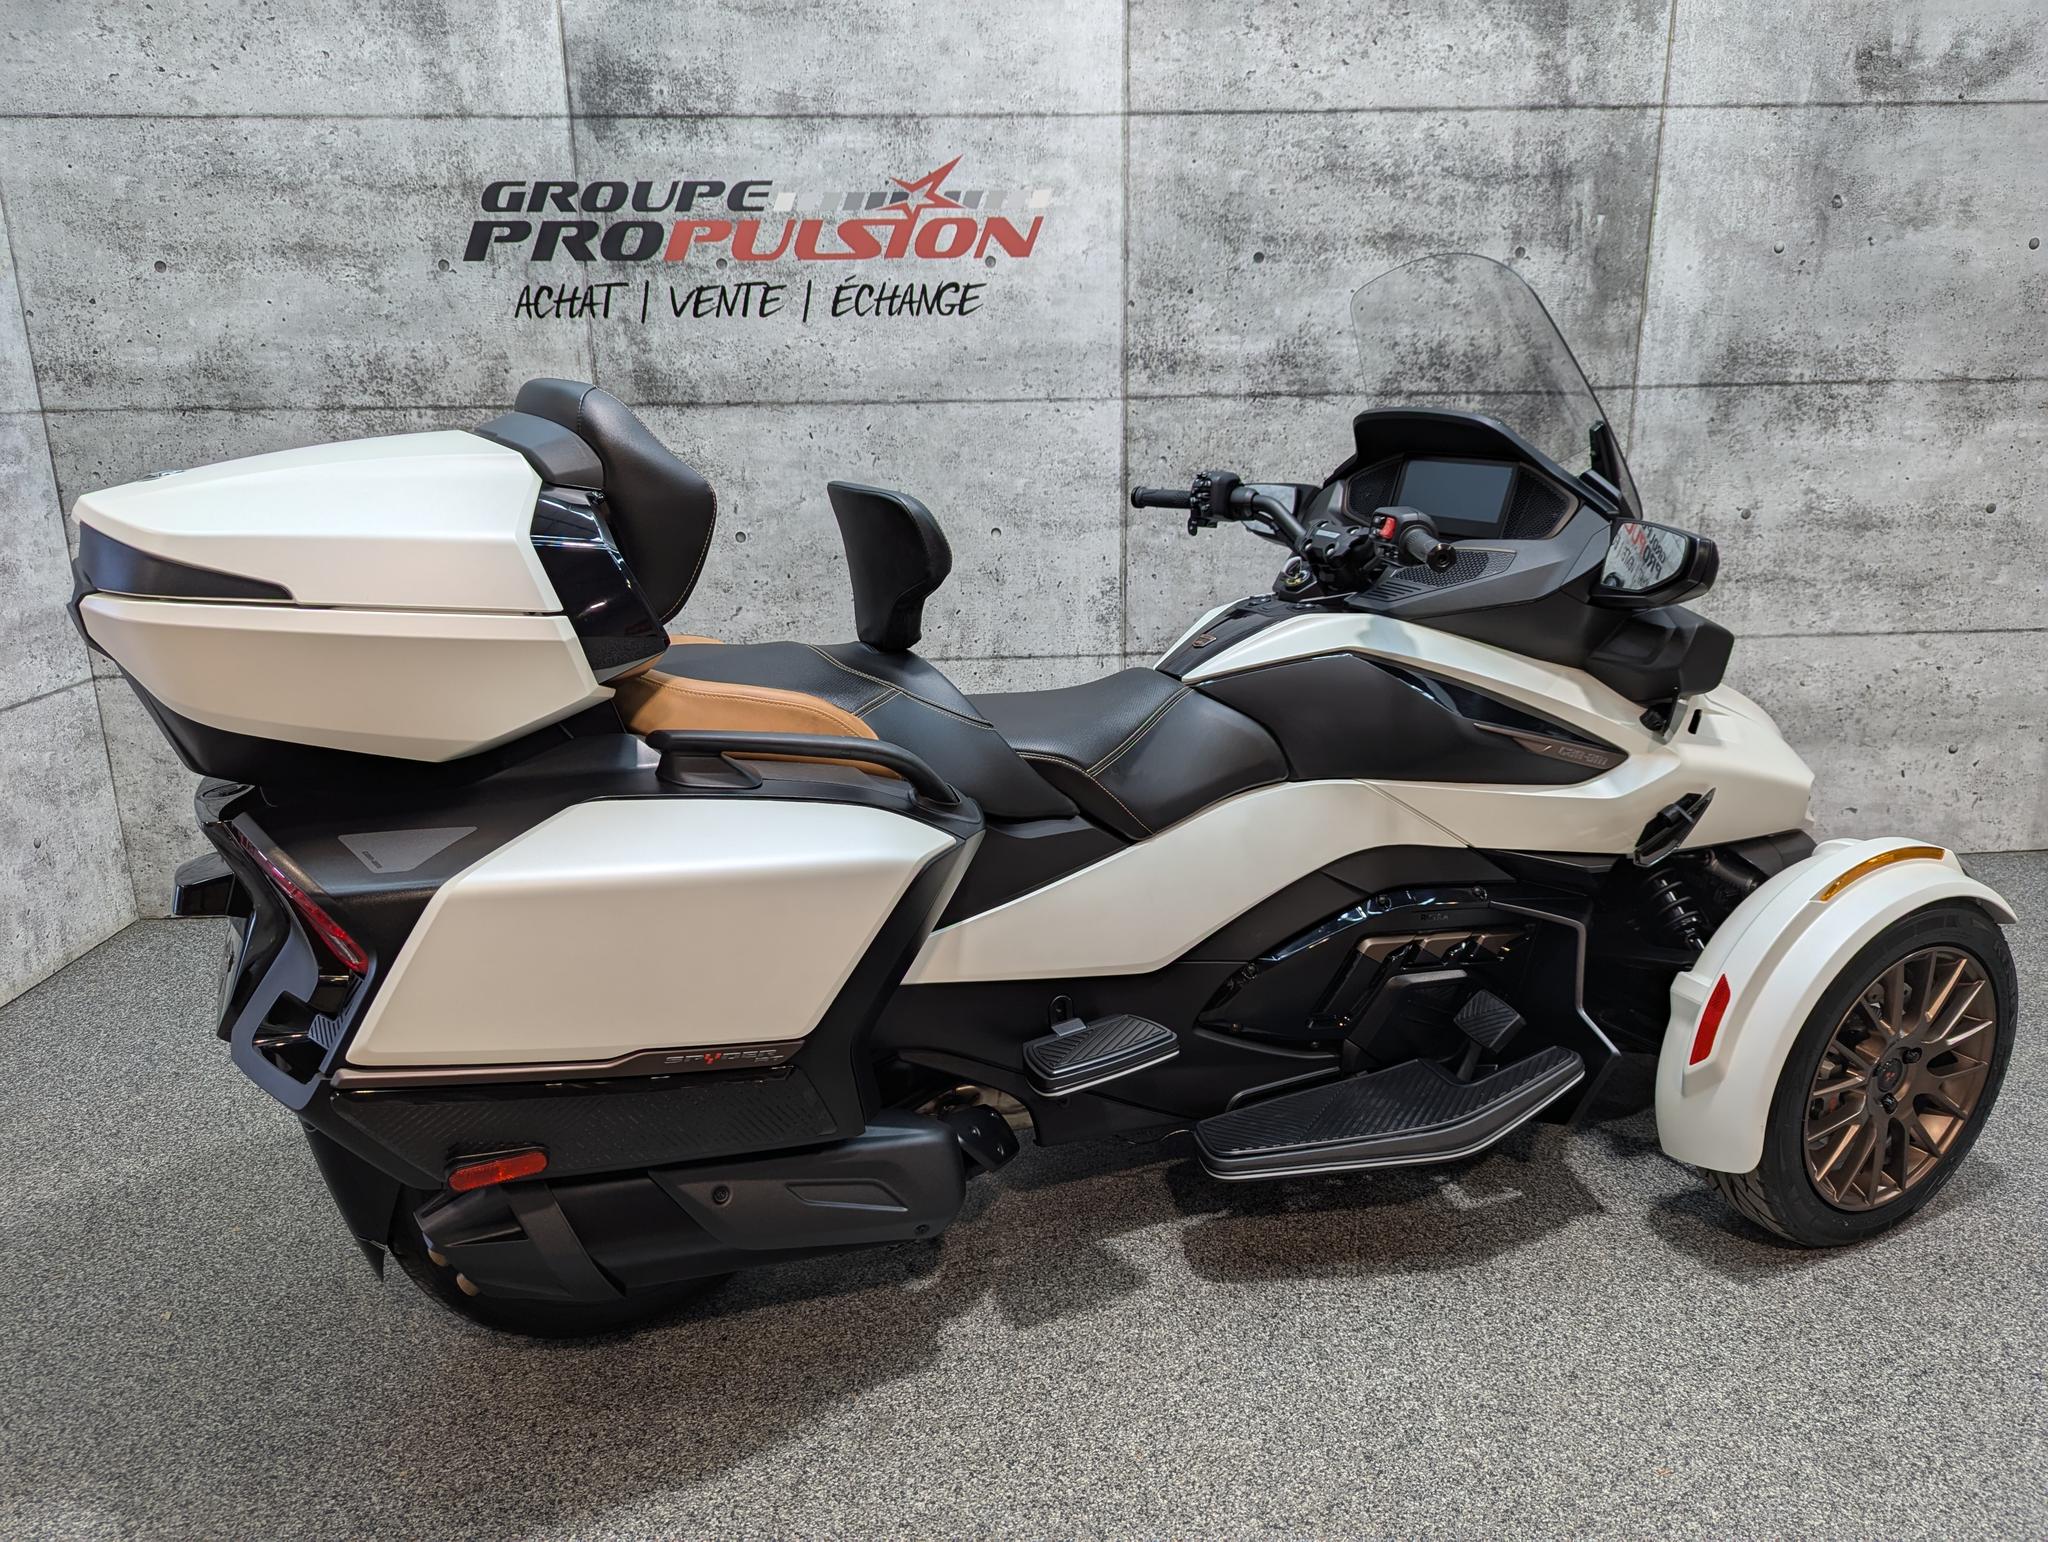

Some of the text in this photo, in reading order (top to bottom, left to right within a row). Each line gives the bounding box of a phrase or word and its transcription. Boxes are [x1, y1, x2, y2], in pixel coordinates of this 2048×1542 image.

[481, 180, 773, 213] GROUPE
[462, 215, 1045, 262] PROPULSION
[514, 281, 629, 319] ACHAT
[669, 281, 787, 318] VENTE
[830, 275, 987, 318] ÉCHANGE
